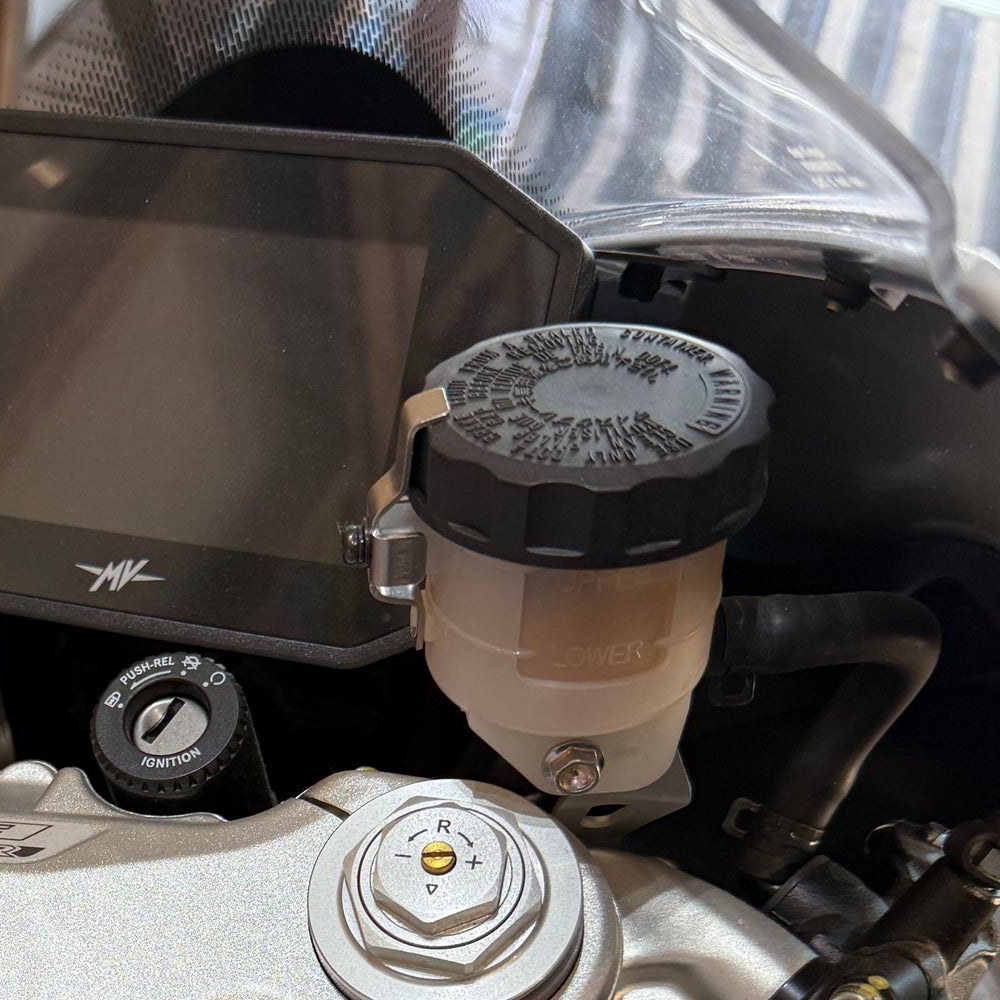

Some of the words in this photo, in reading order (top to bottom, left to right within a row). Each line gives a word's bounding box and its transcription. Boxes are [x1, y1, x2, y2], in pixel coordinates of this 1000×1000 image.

[696, 368, 742, 431] WARNING
[551, 640, 643, 668] LOWER
[119, 656, 175, 686] PUSH-REL
[140, 747, 202, 769] IGNITION
